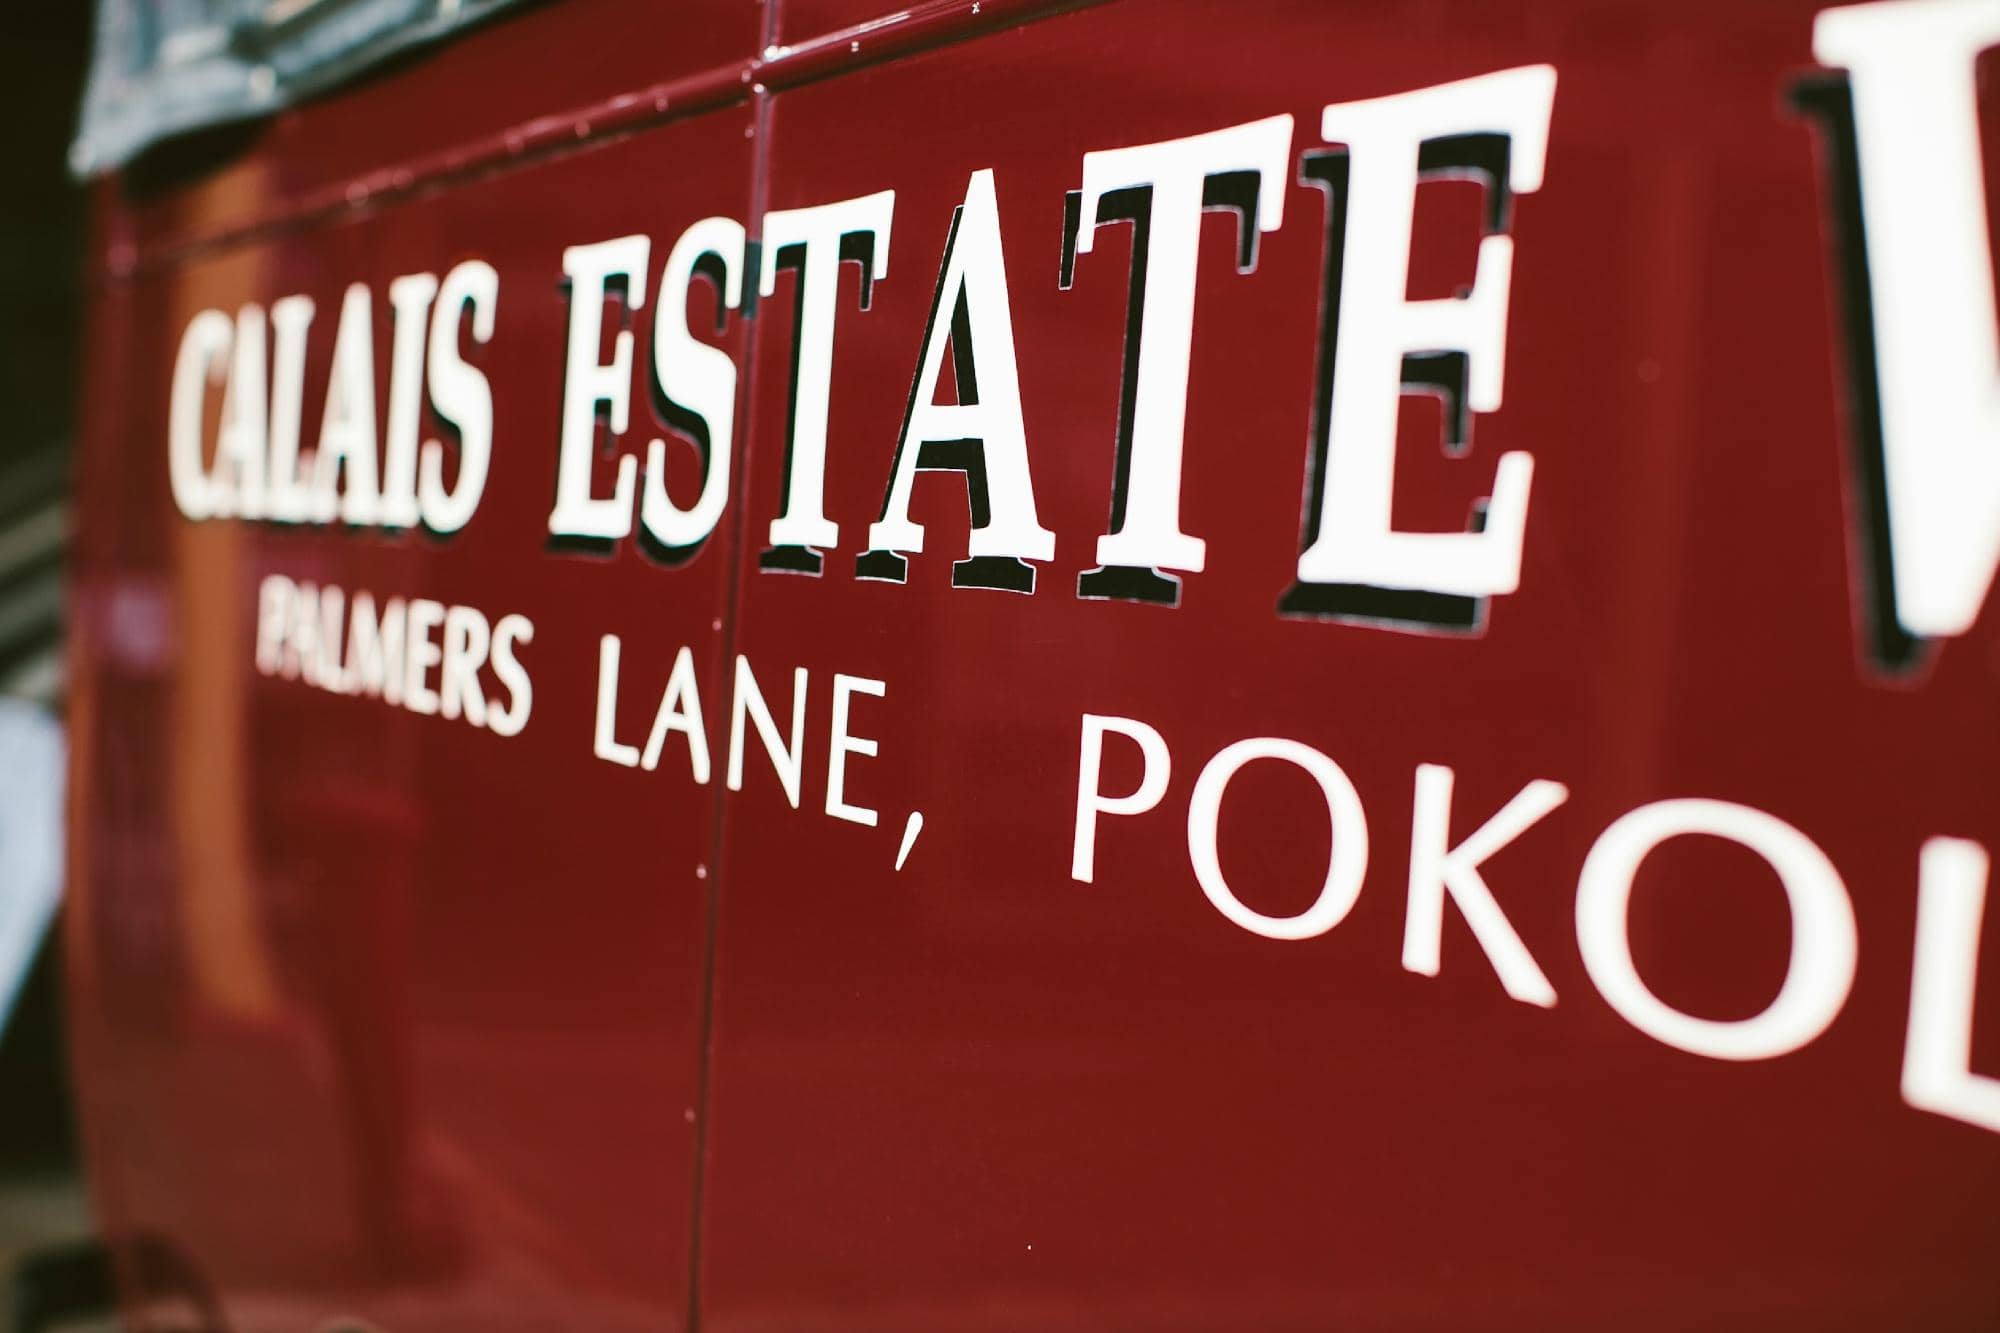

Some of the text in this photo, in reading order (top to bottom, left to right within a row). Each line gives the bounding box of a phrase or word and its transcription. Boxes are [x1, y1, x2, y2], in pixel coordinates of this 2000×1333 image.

[168, 258, 500, 534] CALAIS
[547, 64, 1558, 604] ESTATE
[256, 573, 2000, 1132] PALMERS LANE, POKOL
